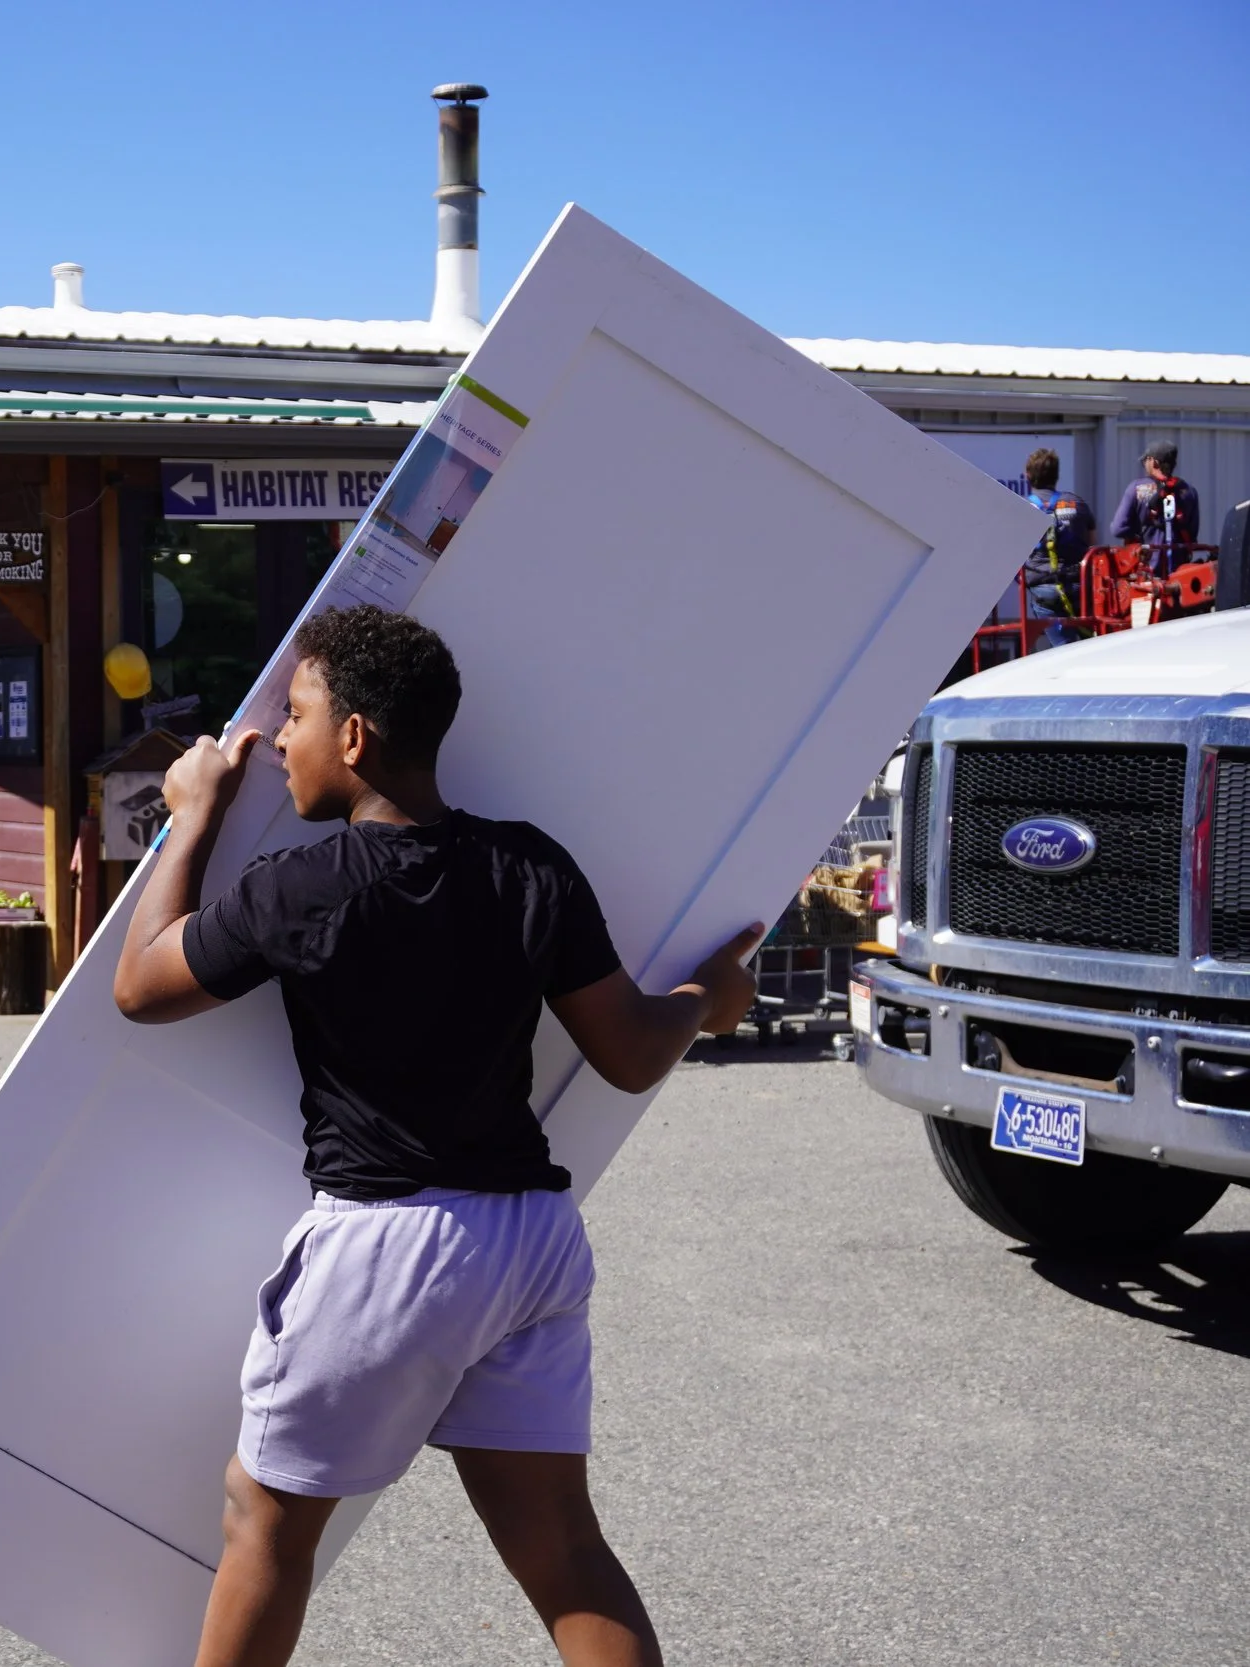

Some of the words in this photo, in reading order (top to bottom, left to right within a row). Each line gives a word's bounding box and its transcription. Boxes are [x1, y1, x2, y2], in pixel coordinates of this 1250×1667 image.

[440, 412, 477, 440] HERITAGE
[476, 436, 502, 457] SERIES
[221, 470, 328, 507] HABITAT
[337, 470, 393, 507] RES
[11, 532, 43, 556] YOU
[1016, 828, 1067, 860] Ford
[1022, 1133, 1058, 1146] MONTANA
